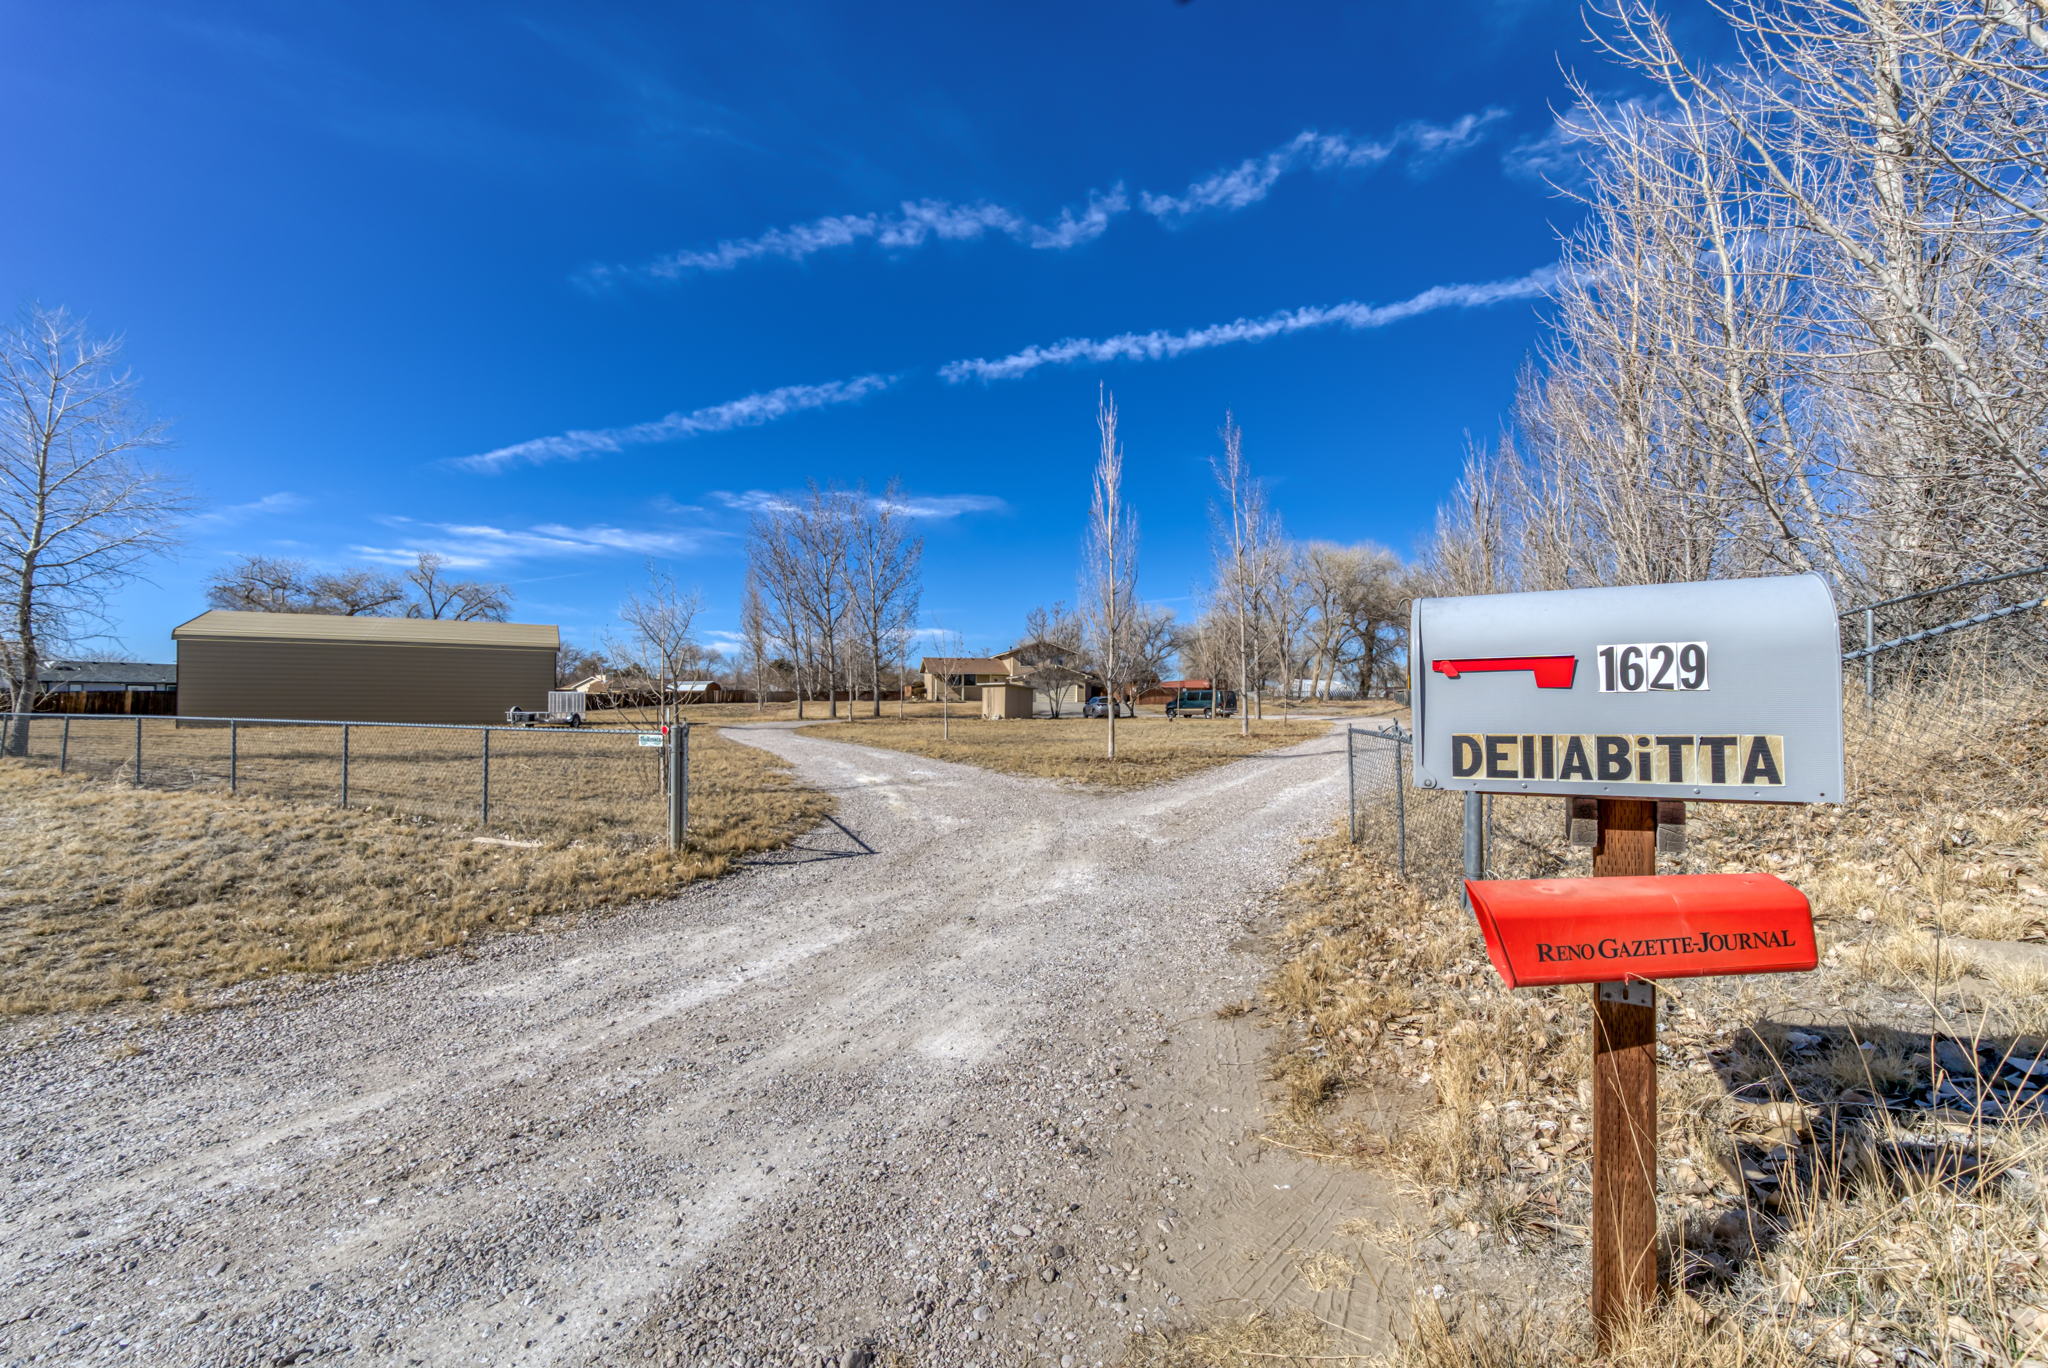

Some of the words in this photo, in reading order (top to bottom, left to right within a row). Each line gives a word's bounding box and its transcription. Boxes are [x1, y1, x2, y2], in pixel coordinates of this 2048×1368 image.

[1599, 643, 1706, 691] 1629
[1536, 943, 1595, 962] RENO
[1597, 929, 1796, 959] GAZETTE-JOURNAL
